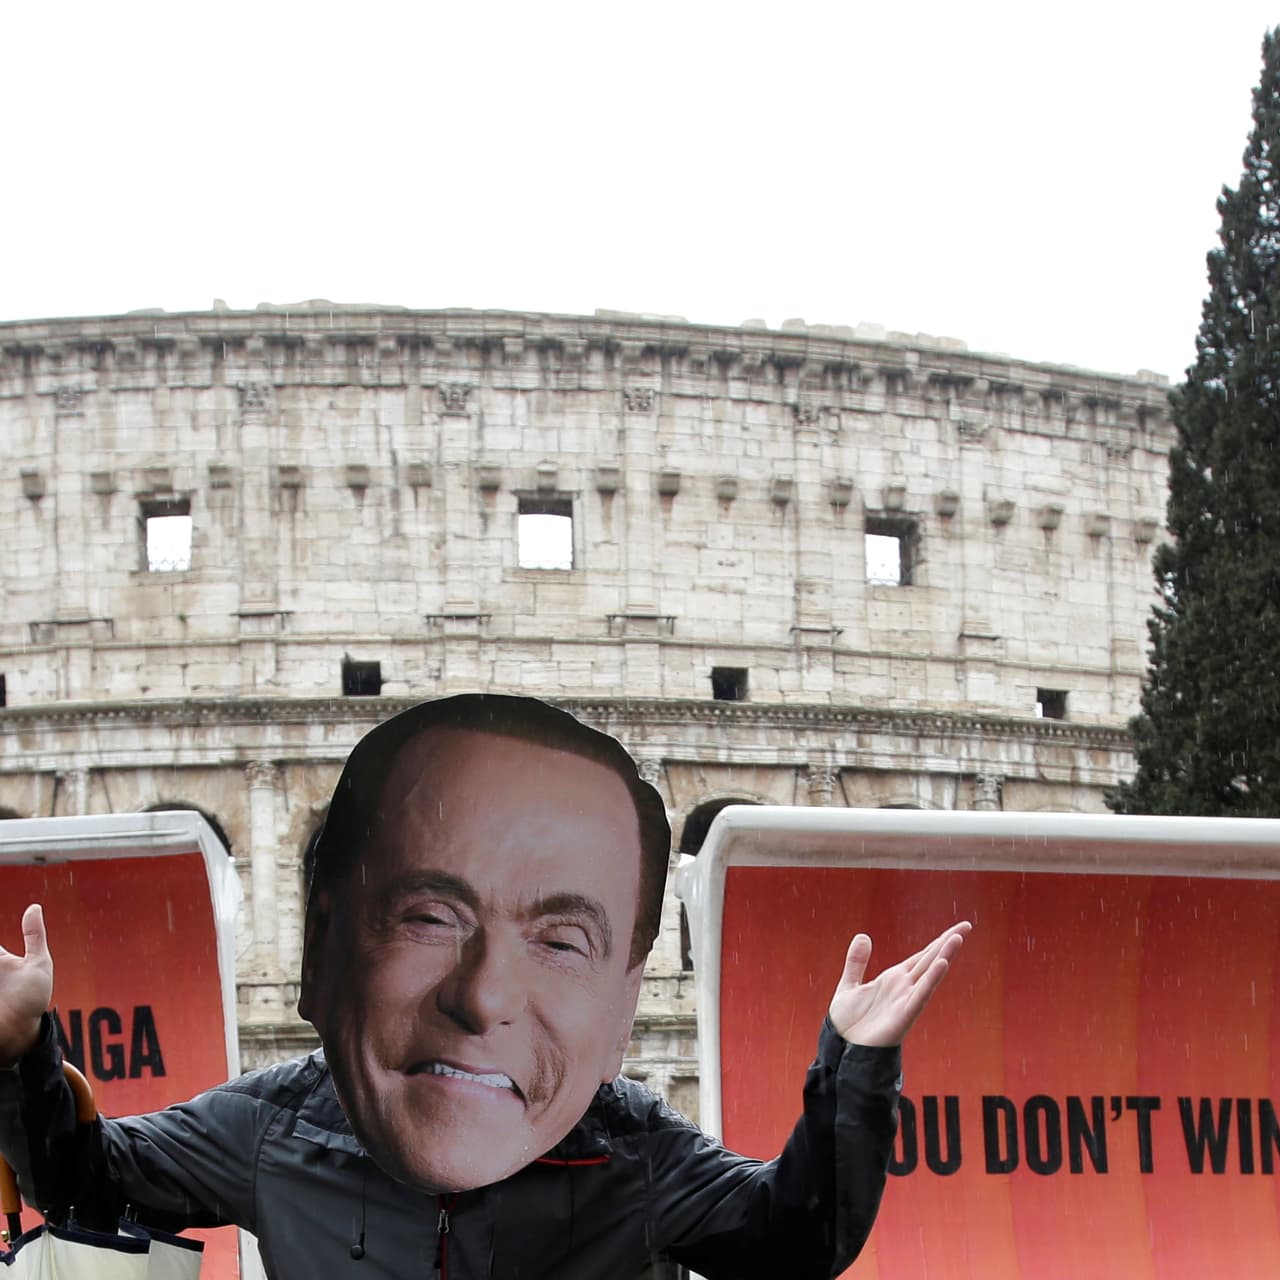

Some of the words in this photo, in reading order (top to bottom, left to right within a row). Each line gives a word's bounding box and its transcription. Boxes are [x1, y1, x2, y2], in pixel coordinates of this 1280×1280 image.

[52, 1005, 167, 1082] NGA
[887, 1095, 962, 1177] OU
[981, 1095, 1161, 1177] DON'T
